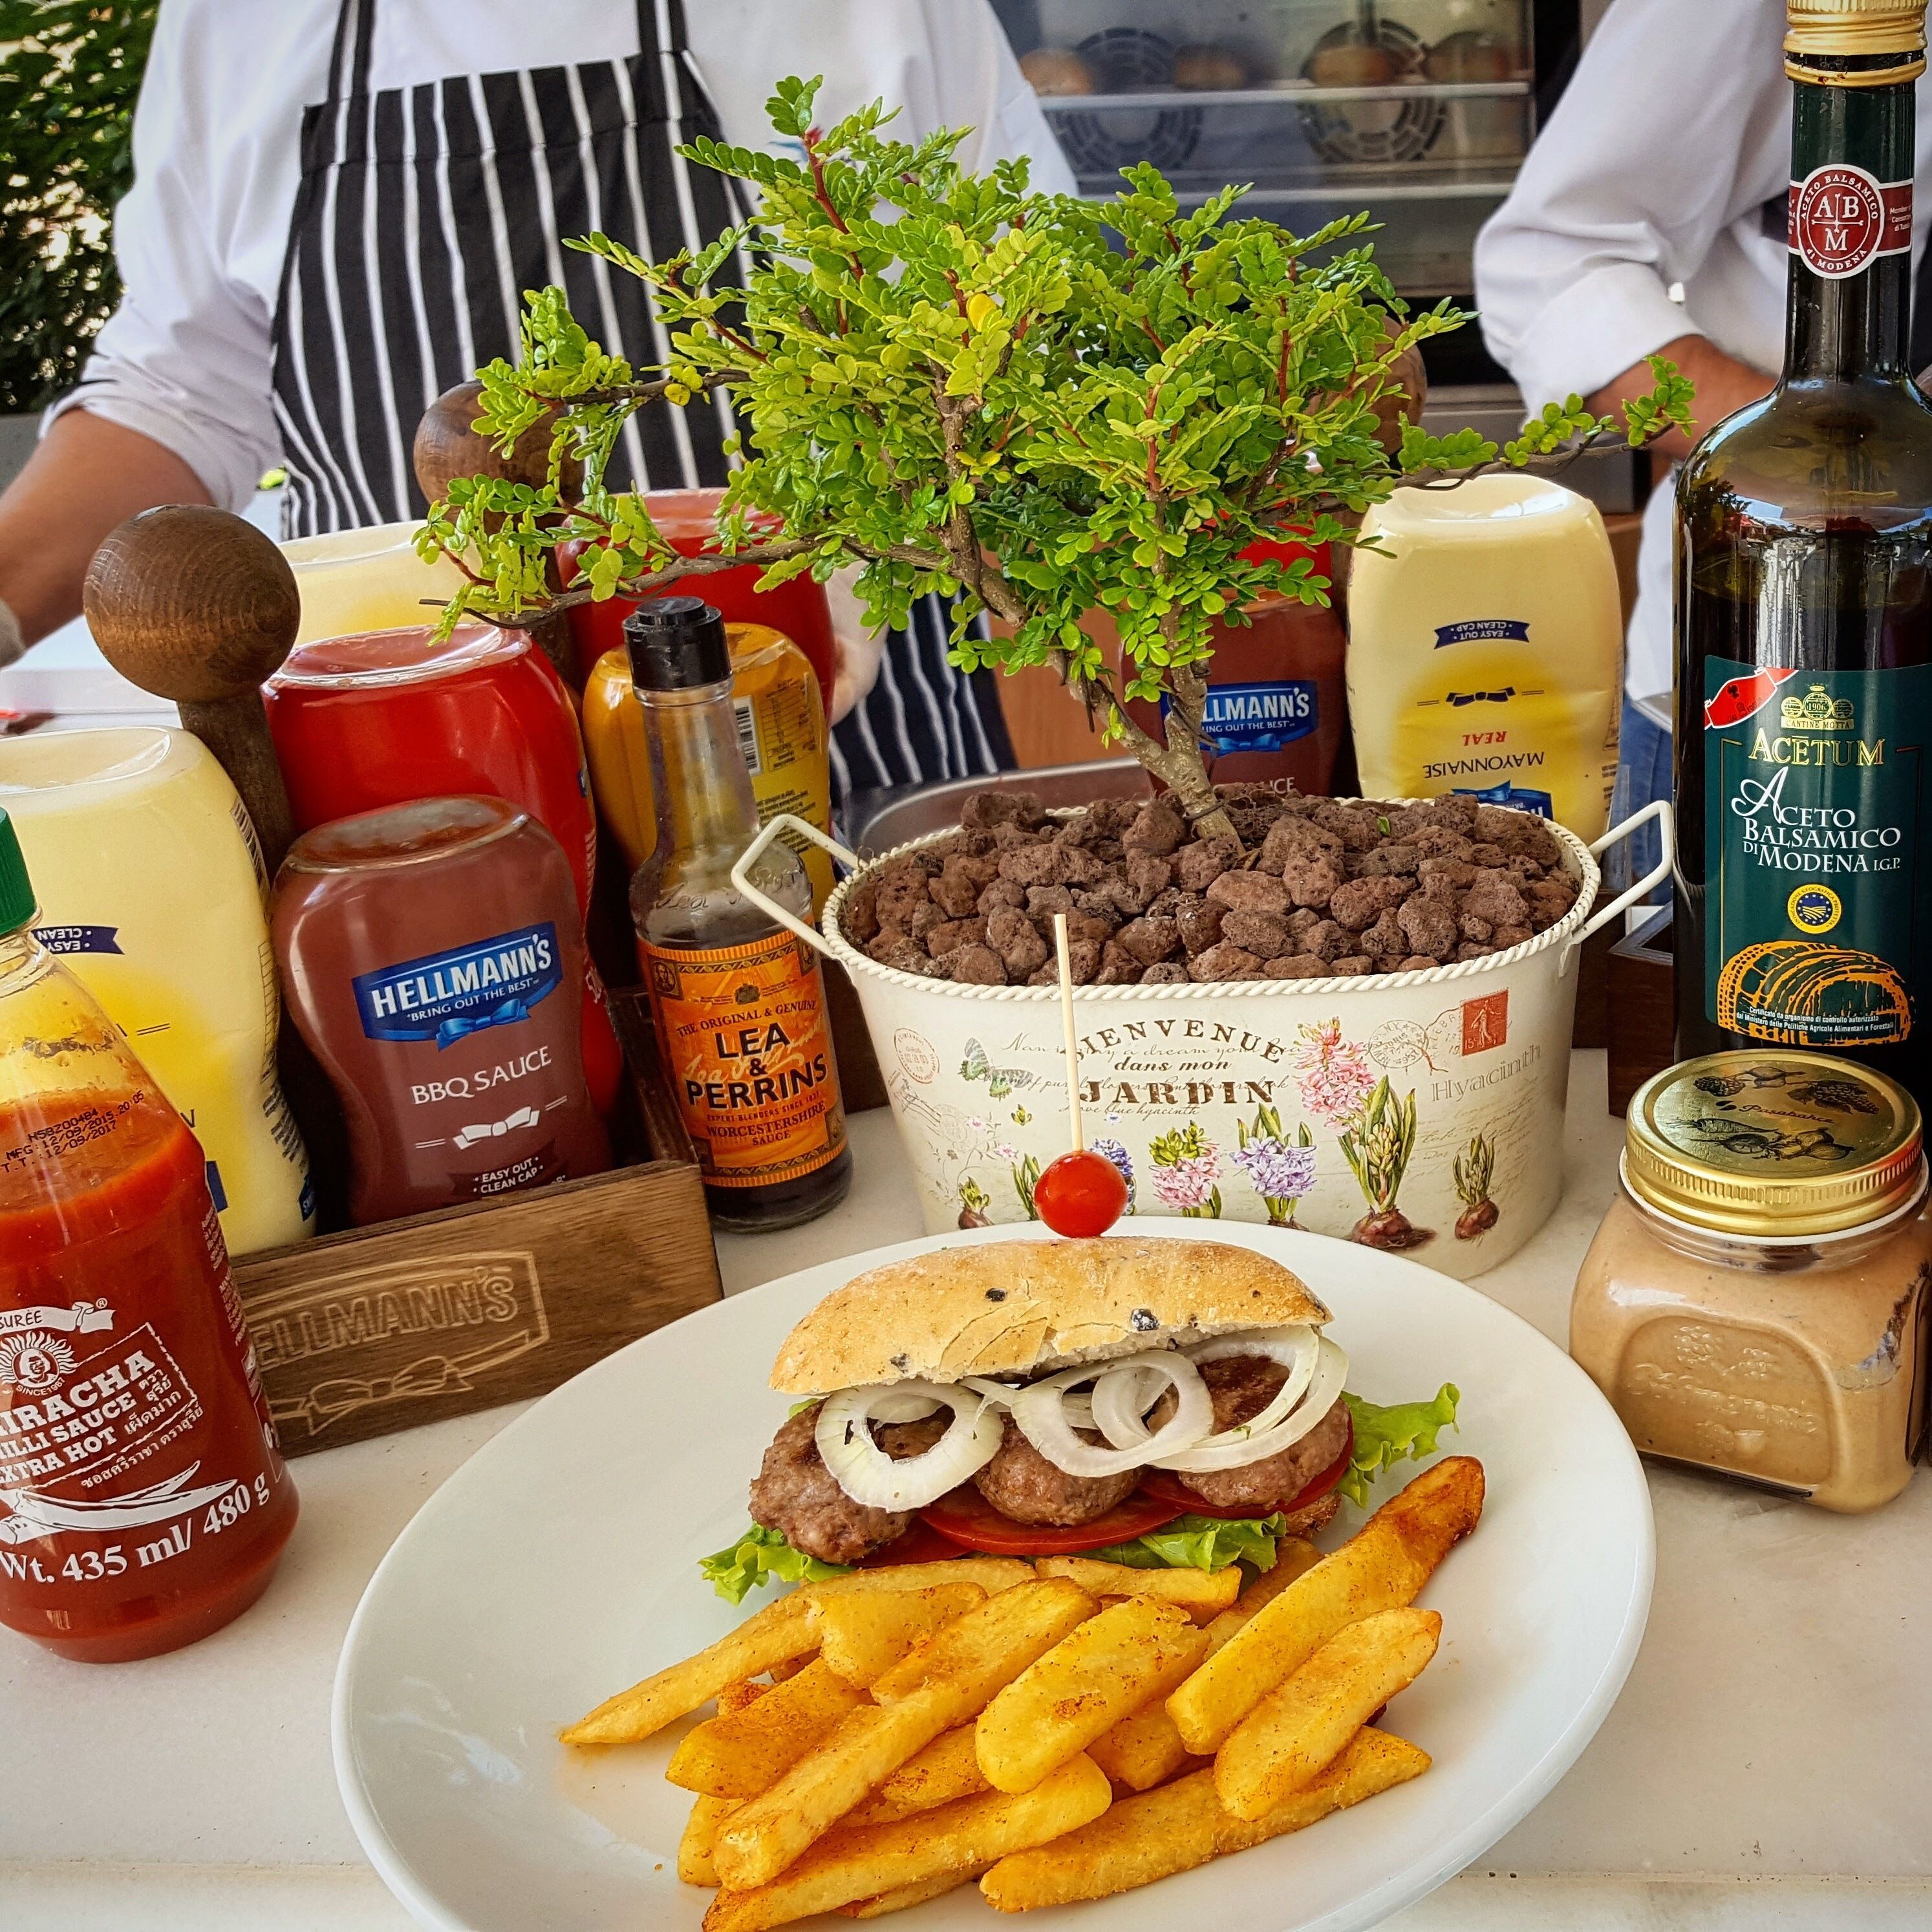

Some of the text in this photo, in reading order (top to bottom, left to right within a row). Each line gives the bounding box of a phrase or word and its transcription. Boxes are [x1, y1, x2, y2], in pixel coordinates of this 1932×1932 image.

[1801, 182, 1821, 220] ACETO
[1824, 174, 1878, 219] BALSAMICO
[1817, 249, 1867, 270] MODENA
[1457, 623, 1475, 632] CAP
[1460, 632, 1479, 640] OUT
[1203, 687, 1310, 722] LLMANN'S
[1225, 724, 1245, 732] OUT
[1786, 720, 1850, 729] CANTINE MOTTA
[1461, 731, 1507, 747] REAL
[1424, 751, 1545, 778] MAYONNAISE
[1743, 817, 1901, 849] BALSAMICO
[1743, 841, 1758, 855] DI
[1757, 844, 1869, 873] MODENA
[38, 928, 83, 941] CLEAN
[47, 940, 81, 952] EASY
[371, 934, 552, 1018] HELLMANN'S
[455, 995, 479, 1009] OUT
[484, 988, 506, 1001] THE
[677, 1000, 817, 1037] THE ORIGINAL & GENUINE
[1785, 1014, 1814, 1022] organismo
[1810, 1024, 1833, 1033] Agricole
[714, 1022, 792, 1060] LEA
[1060, 1019, 1285, 1064] IENVENUE
[410, 1046, 552, 1105] BBQ SAUCE
[749, 1057, 768, 1077] &
[1114, 1057, 1232, 1071] dans mon
[1431, 1044, 1542, 1102] Hyacinth
[685, 1053, 828, 1110] PERRINS
[1079, 1081, 1272, 1104] JARDIN
[707, 1100, 826, 1137] WORCESTERSHIRE
[738, 1109, 779, 1121] BLENDERS
[782, 1100, 803, 1113] SINCE
[1137, 1102, 1201, 1122] hyacinth
[752, 1130, 791, 1146] SAUCE
[480, 1177, 516, 1194] CLEAN
[518, 1167, 538, 1183] CAP
[482, 1158, 532, 1183] EASY OUT
[249, 1265, 519, 1373] ELLMANN'S
[50, 1391, 137, 1443] SAUCE
[63, 1426, 118, 1463] HOT
[0, 1551, 55, 1583] Wt.
[62, 1545, 128, 1582] 435
[202, 1485, 252, 1536] 480
[253, 1472, 271, 1507] g
